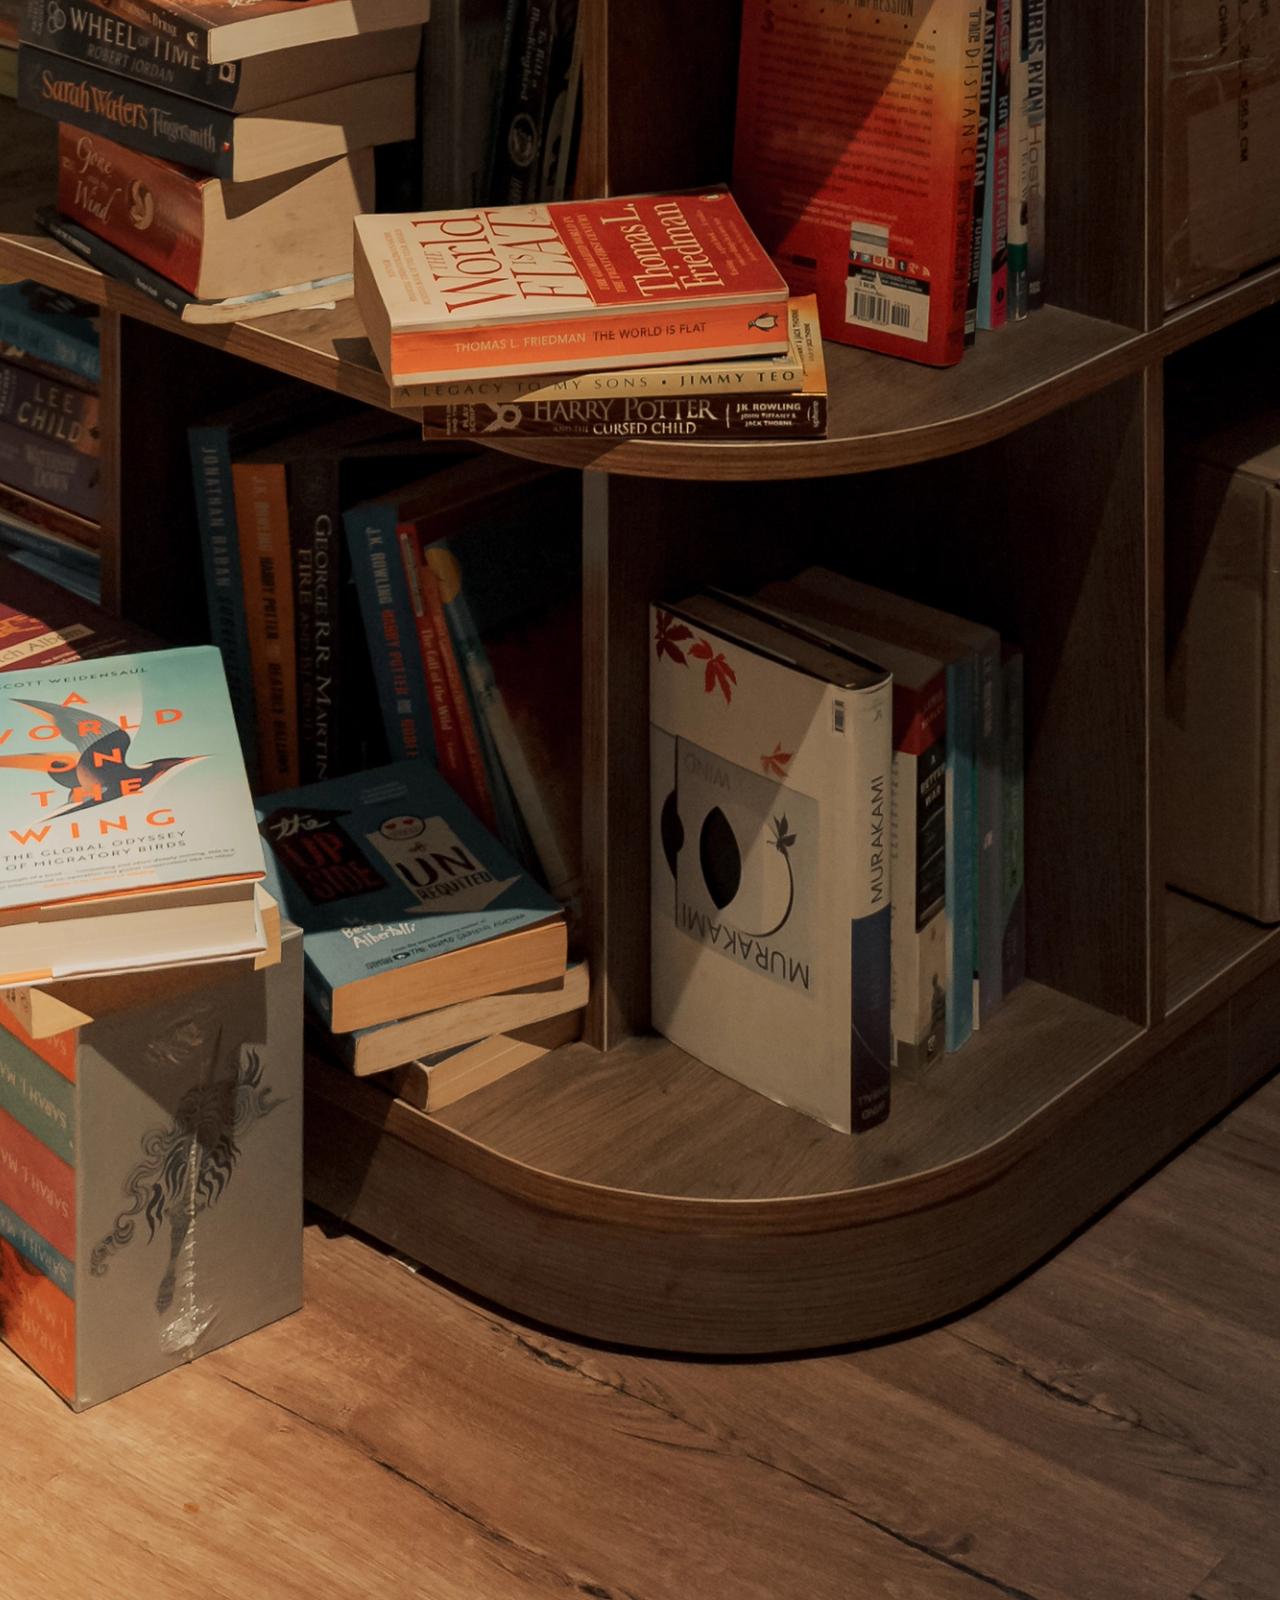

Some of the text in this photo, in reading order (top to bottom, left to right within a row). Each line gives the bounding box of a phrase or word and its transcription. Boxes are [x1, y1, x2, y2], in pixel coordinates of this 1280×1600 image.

[70, 7, 202, 71] WHEEL TIME
[1026, 60, 1045, 117] RYAN
[41, 69, 217, 153] Sarah Waters Fingersmith
[483, 210, 596, 303] FLAT
[621, 226, 682, 298] Thomas
[653, 201, 726, 291] Friedman
[411, 214, 518, 314] World
[454, 322, 707, 354] THOMAS FRIEDMAN THE WORLD IS FLAT
[33, 382, 75, 414] LEE
[423, 369, 796, 397] LEGACY MY SONS JIMMY TEO
[17, 401, 81, 443] CHILD
[532, 396, 719, 422] HARRY POTTER
[752, 402, 802, 412] ROWLING
[592, 421, 697, 436] CURSED CHILD
[314, 513, 332, 618] GEORGE
[48, 667, 149, 686] WEIDENSAUL
[61, 691, 89, 708] A
[49, 747, 124, 773] ON
[30, 777, 144, 807] THE
[8, 808, 176, 846] WING
[870, 775, 884, 904] MURAKAMI
[3, 830, 187, 863] THE GLOBAL ODYSSEY
[5, 839, 187, 872] OF MIGRATORY BIRDS
[395, 845, 476, 888] UN
[415, 870, 494, 902] REQUITED
[680, 902, 810, 991] MURAKAMI
